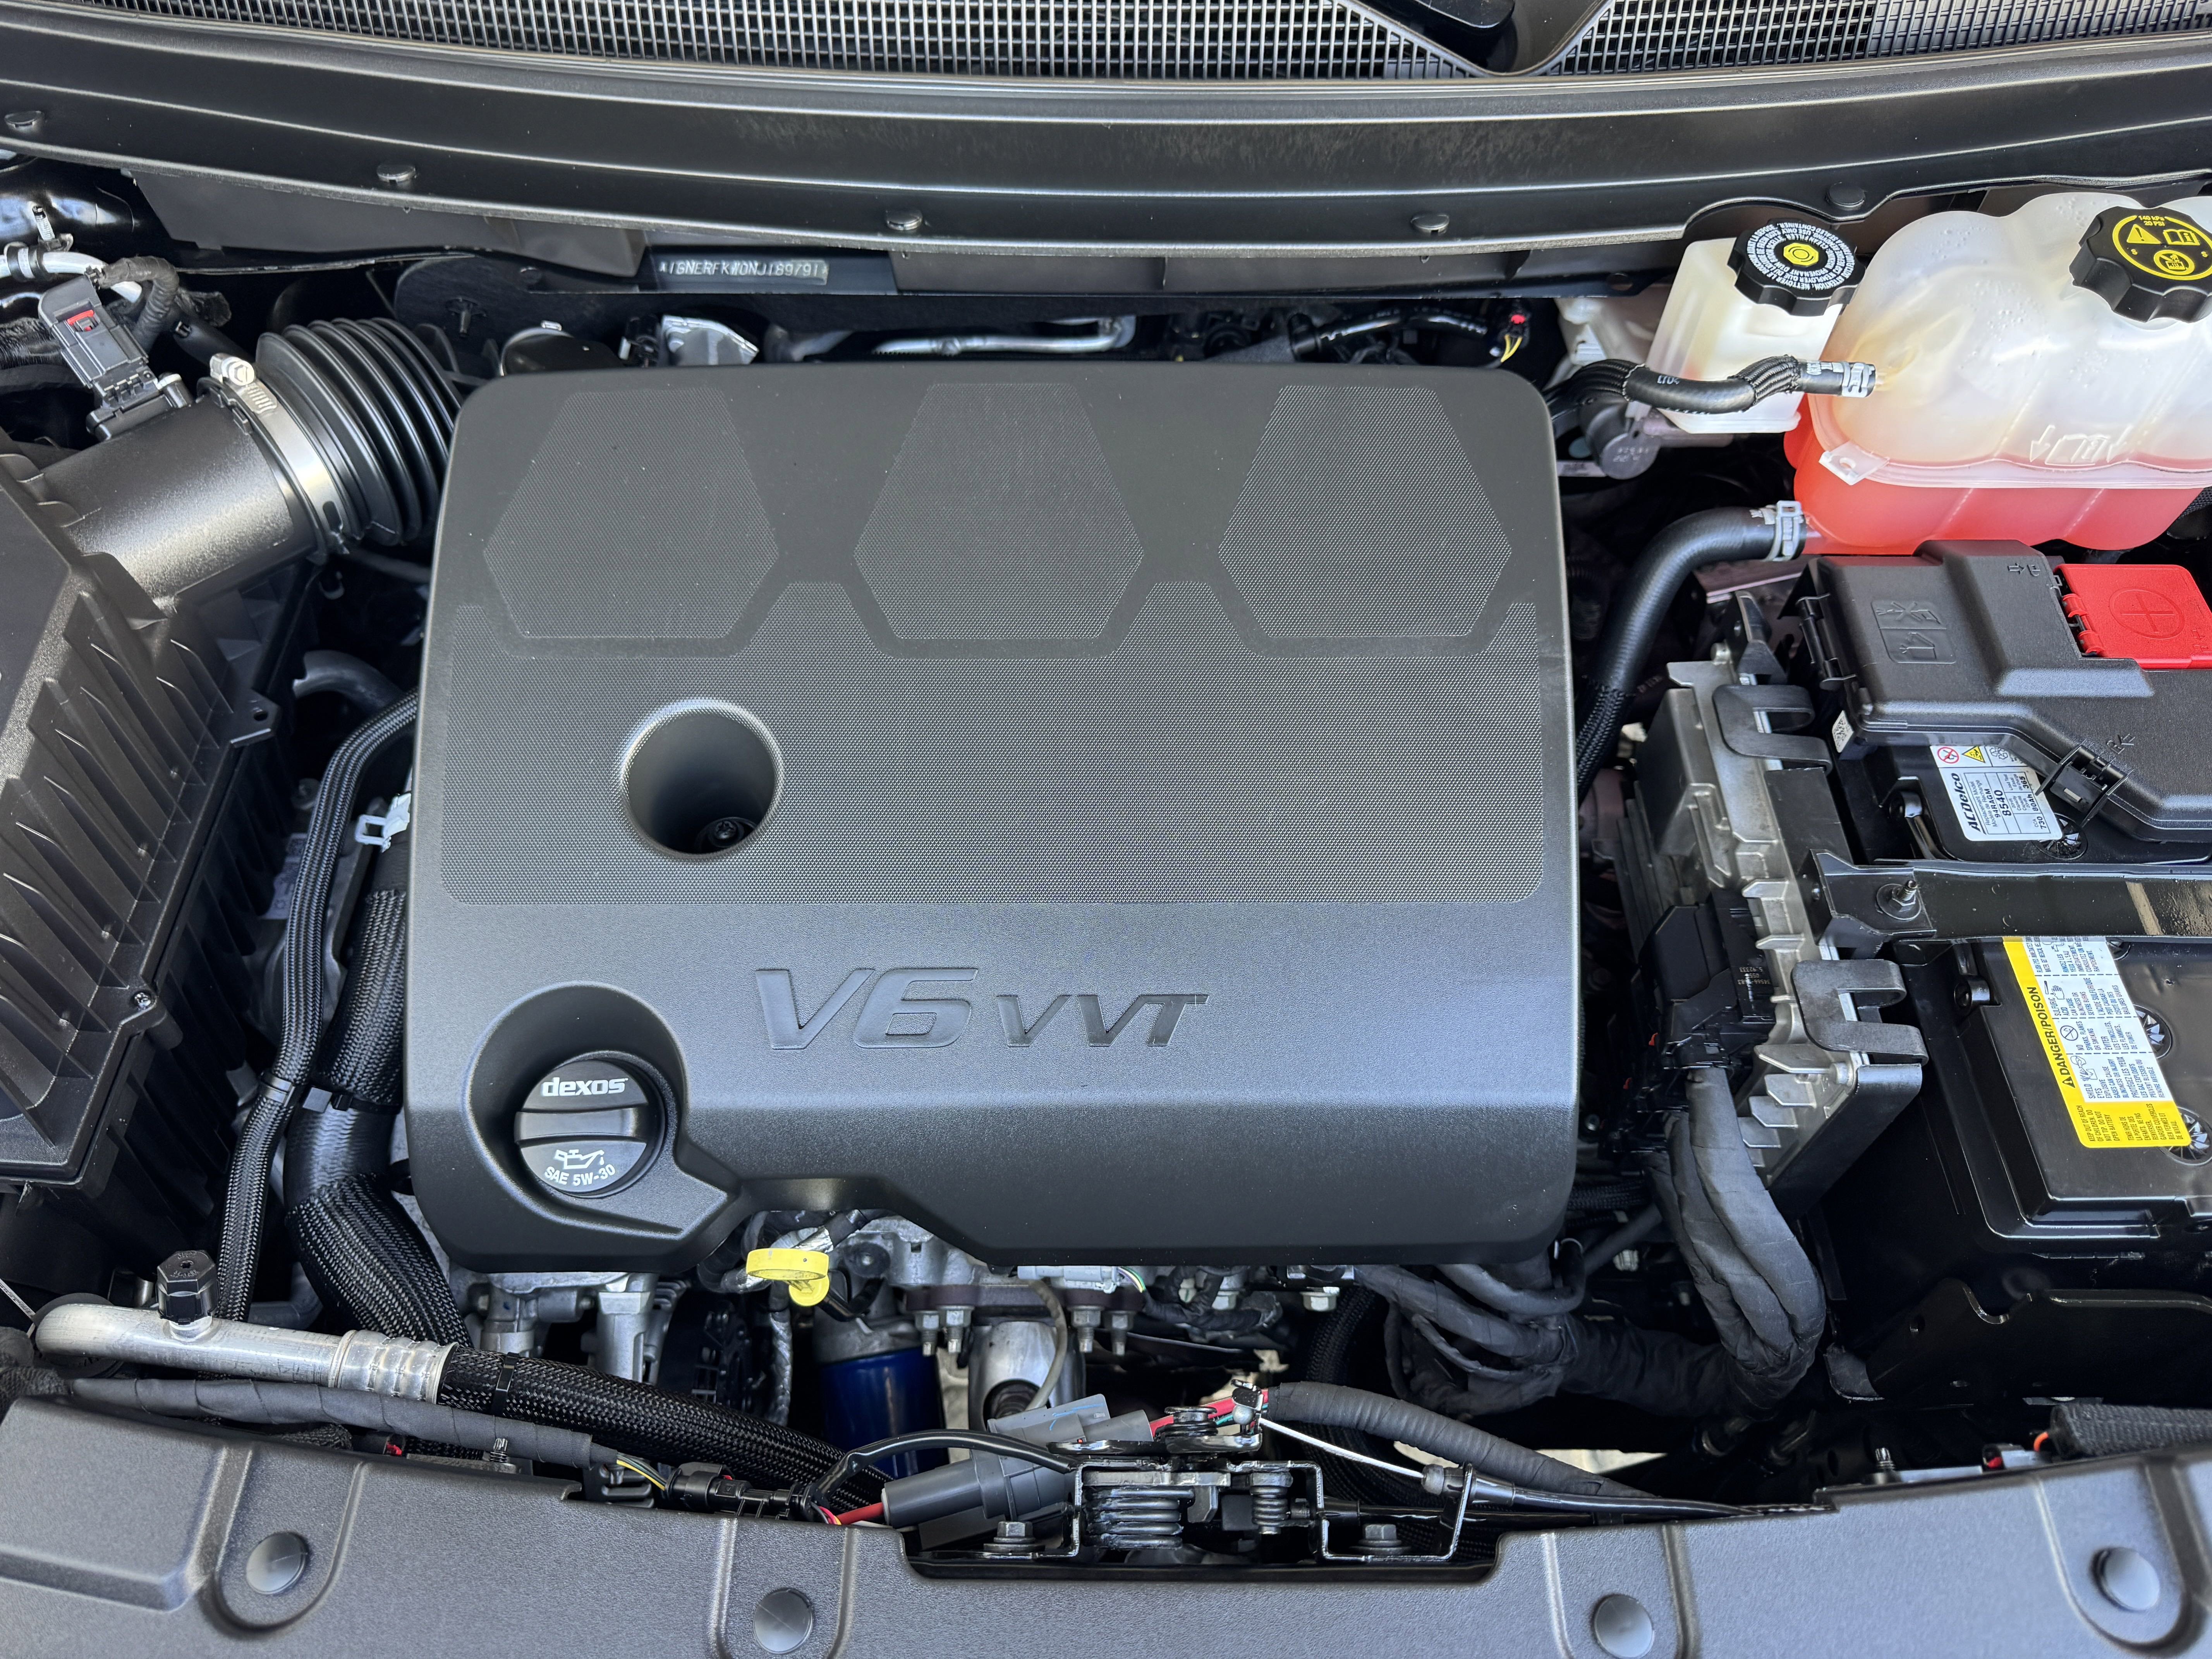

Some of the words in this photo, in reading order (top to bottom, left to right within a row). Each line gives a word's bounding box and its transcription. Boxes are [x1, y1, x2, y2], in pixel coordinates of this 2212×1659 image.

[1777, 222, 1816, 232] CONTAINER.
[1785, 233, 1809, 242] FILLER
[1815, 228, 1839, 241] SEALED
[1808, 236, 1829, 249] CLEAN
[1783, 273, 1798, 282] QUE
[1789, 268, 1829, 278] PROVENANT
[1776, 276, 1810, 290] NETTOYER
[1812, 276, 1844, 290] ATTENTION,
[1969, 781, 1978, 795] Model
[2019, 776, 2029, 788] 365
[1951, 773, 1980, 832] ACDelco
[1984, 789, 2001, 817] 94RAGM
[1994, 790, 2011, 816] 8540
[2027, 794, 2038, 811] 80Ah
[1974, 796, 1992, 825] Replacement
[2037, 816, 2046, 829] 730
[2079, 953, 2092, 972] CONSULTEZ
[2083, 977, 2099, 1000] SULFURIQUE
[2066, 998, 2075, 1008] CAUSE
[2079, 991, 2089, 1002] BURNS
[754, 967, 979, 1050] V6
[996, 994, 1208, 1048] VVT
[2048, 998, 2061, 1016] SULFURIC
[2060, 1007, 2069, 1015] ACID
[2074, 998, 2086, 1015] BLINDNESS
[2027, 987, 2070, 1075] DANGER/POISON
[2076, 1021, 2086, 1034] FLAMES
[2087, 1028, 2099, 1044] SMOKING
[2125, 1032, 2135, 1044] FUMER
[2116, 1056, 2126, 1067] YEUX
[2102, 1066, 2112, 1077] CAUSE
[2138, 1065, 2149, 1080] BLESSER
[542, 1077, 625, 1096] dexos
[2083, 1084, 2096, 1098] SHIELD
[2094, 1088, 2104, 1098] EYES
[2099, 1079, 2112, 1098] EXPLOSIVE
[2110, 1087, 2120, 1098] GASES
[2076, 1105, 2086, 1117] REACH
[2103, 1114, 2115, 1130] BATTERY
[2087, 1132, 2095, 1141] KEEP
[2111, 1131, 2120, 1141] OPEN
[544, 1166, 569, 1185] SAE
[573, 1163, 616, 1186] 5W-30
